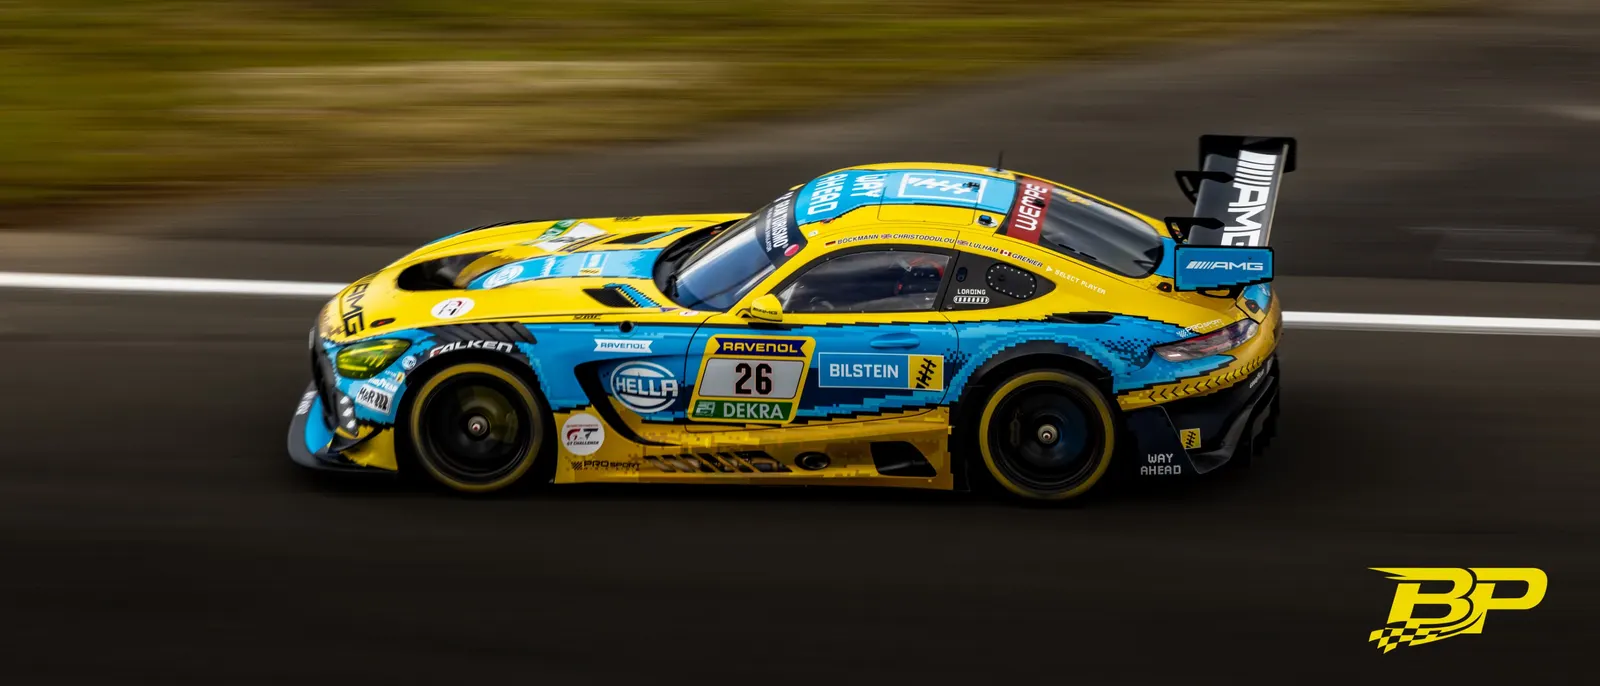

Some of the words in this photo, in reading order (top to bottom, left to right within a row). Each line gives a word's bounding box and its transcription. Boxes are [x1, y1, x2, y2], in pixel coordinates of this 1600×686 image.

[807, 173, 849, 216] AHEAD
[850, 173, 888, 198] WAY
[1014, 183, 1048, 231] WEMPE
[837, 234, 879, 245] BOCKMANN
[892, 233, 955, 244] CHRISTODOULOU
[968, 241, 999, 253] LULHAM
[1011, 253, 1043, 268] GRENIER
[1210, 261, 1264, 271] AMG
[1054, 269, 1080, 284] SELECT
[1080, 280, 1106, 295] PLAYER
[957, 288, 987, 296] LOADING
[342, 283, 369, 338] AMG
[429, 339, 513, 358] FALKEN
[600, 342, 646, 350] RAVENOL
[722, 341, 799, 354] RAVENOL
[734, 362, 773, 396] 26
[829, 363, 900, 379] BILSTEIN
[358, 386, 375, 404] H&R
[616, 376, 679, 398] HELLA
[723, 402, 785, 420] DEKRA
[609, 461, 641, 469] SPORT
[1147, 453, 1174, 464] WAY
[1140, 464, 1182, 476] AHEAD
